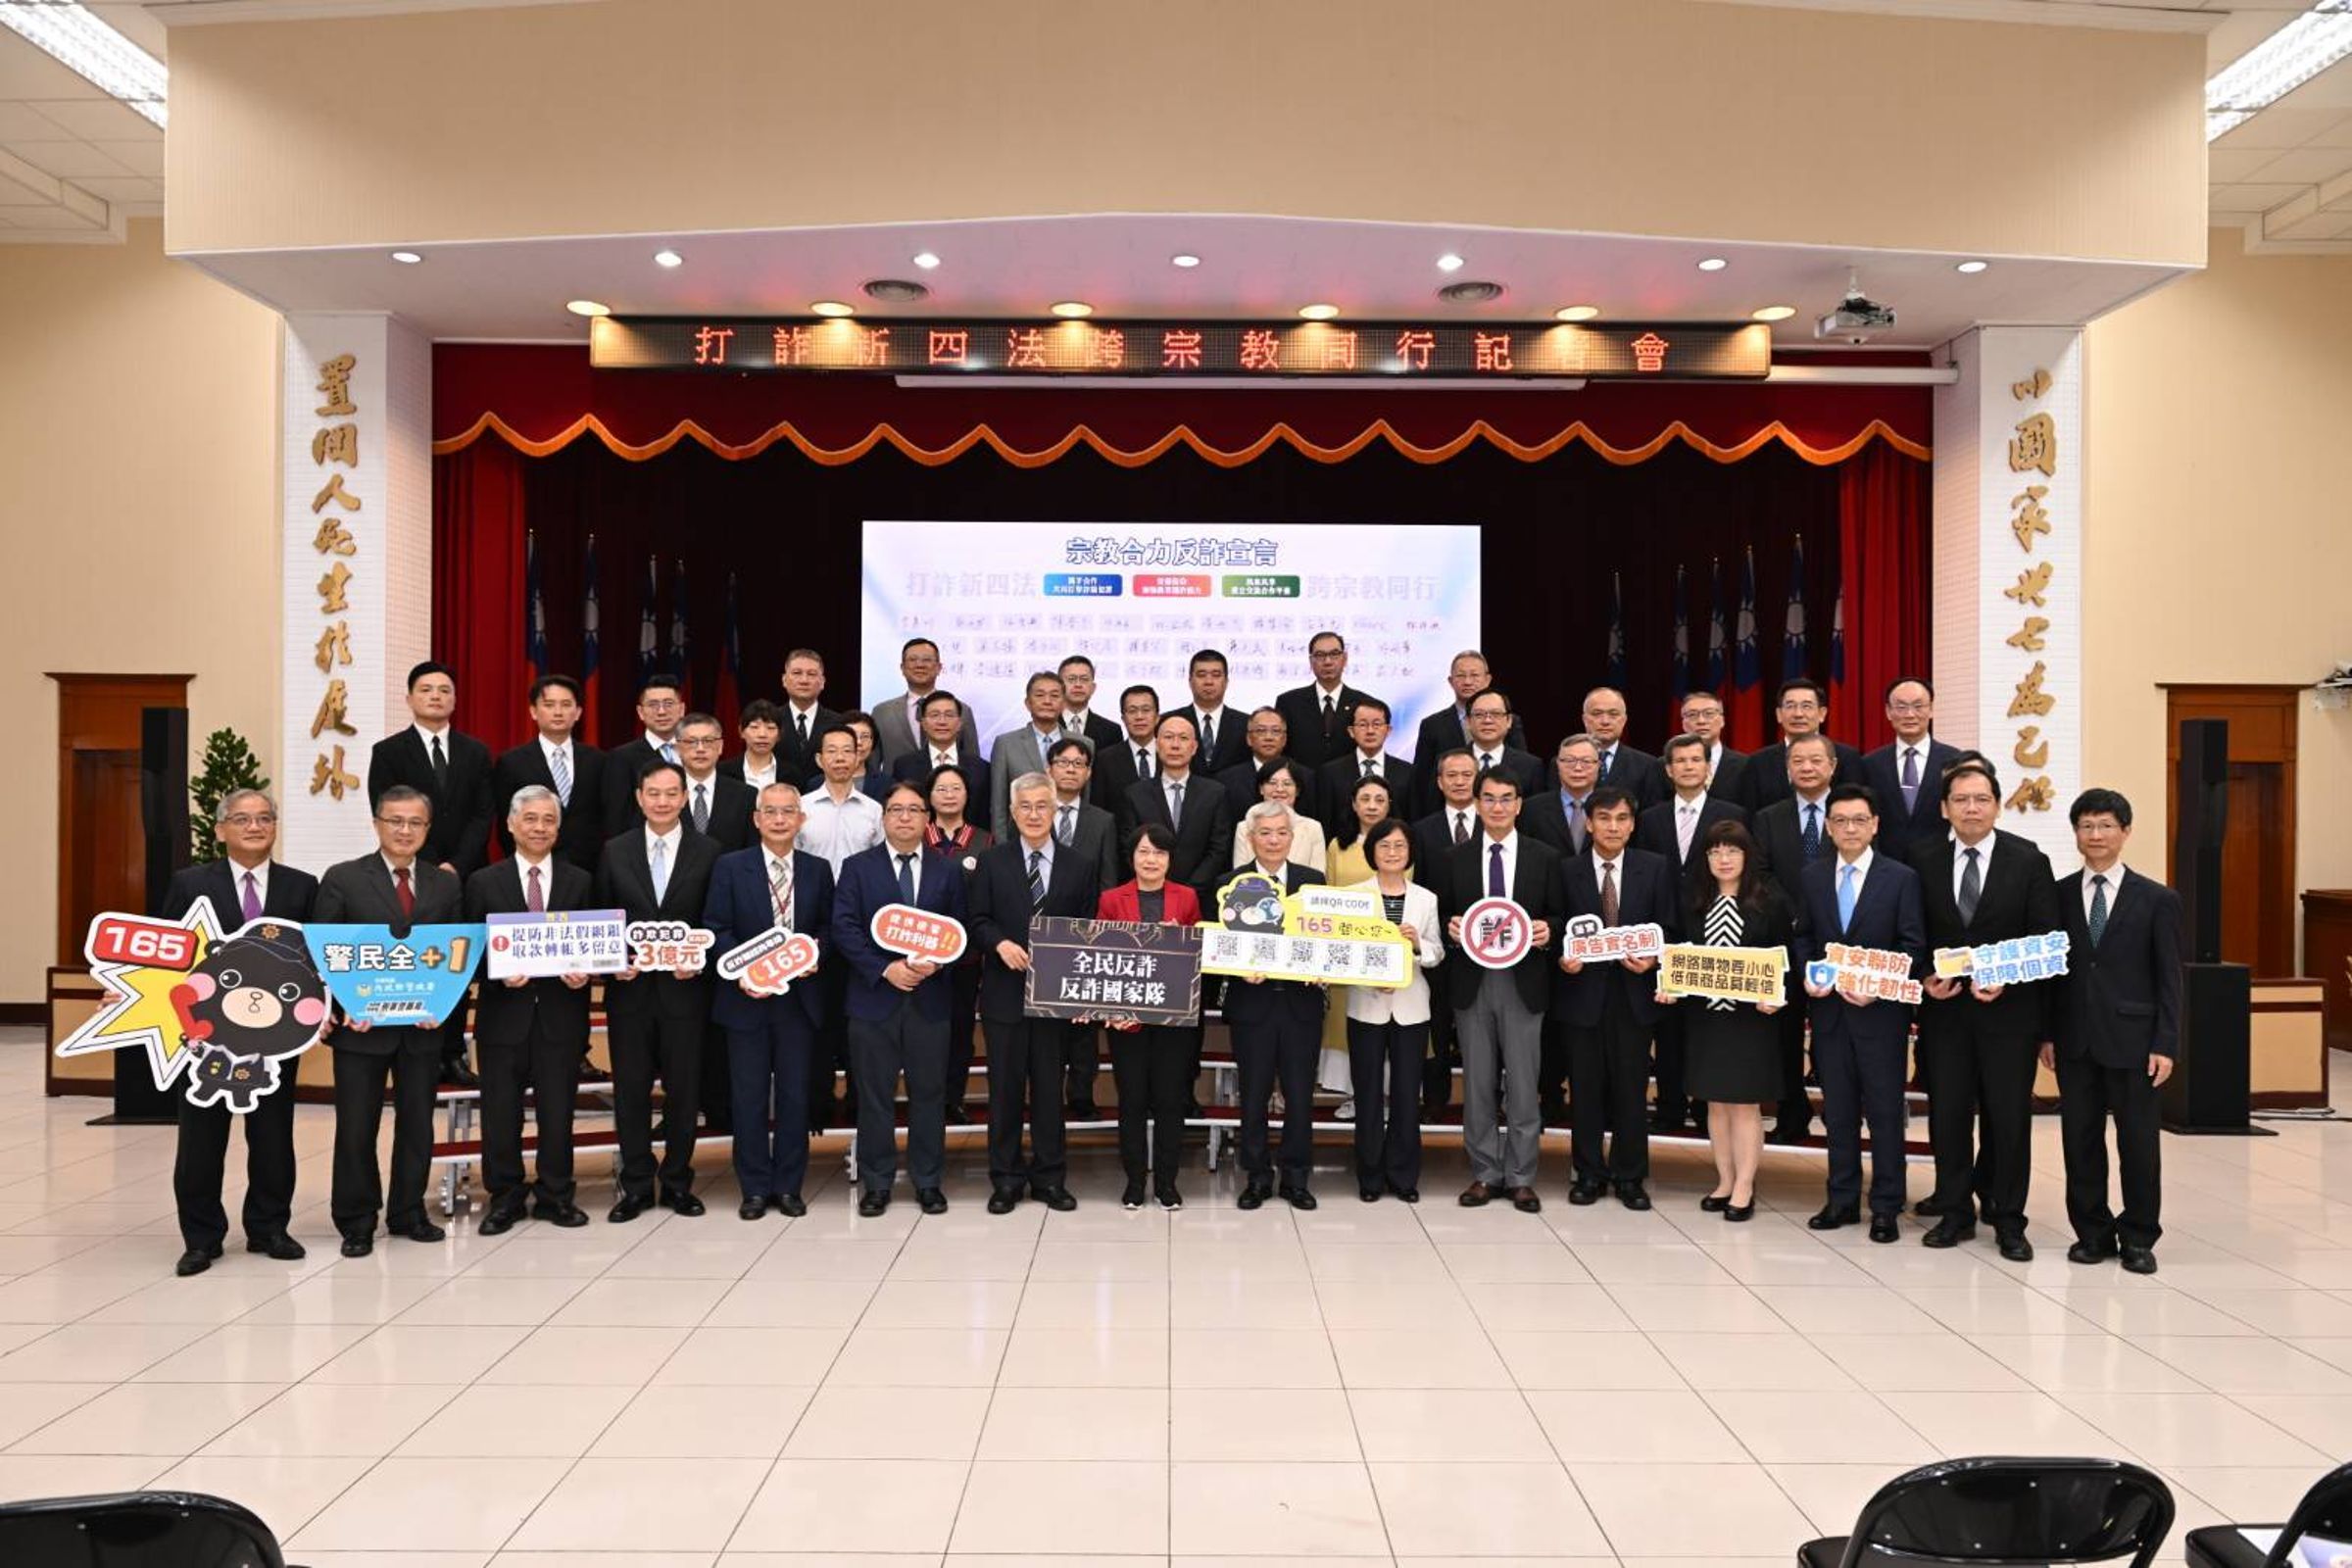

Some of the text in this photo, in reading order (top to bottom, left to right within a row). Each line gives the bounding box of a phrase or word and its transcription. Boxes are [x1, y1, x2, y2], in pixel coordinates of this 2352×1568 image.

[695, 327, 1668, 370] 打詐新四法跨宗教同行記會
[1065, 537, 1278, 566] 宗教合力反詐宣言
[906, 572, 1037, 597] 打詐新四法
[1307, 574, 1442, 601] 跨宗教同行
[1345, 899, 1370, 909] CODE
[1297, 915, 1332, 933] 165
[1480, 915, 1513, 949] 詐
[104, 926, 187, 961] 165
[639, 943, 700, 966] 3億元
[1571, 931, 1656, 956] 廣告實名制
[1976, 934, 2066, 964] 守護資安
[762, 943, 807, 978] 165
[1073, 951, 1157, 978] 全民反詐
[1671, 954, 1775, 978] 網路購物要小心
[1827, 945, 1908, 974] 資安聯防
[1975, 955, 2064, 986] 保障個資
[1059, 977, 1166, 1005] 反詐國家隊
[1838, 970, 1921, 1002] 強化韌性
